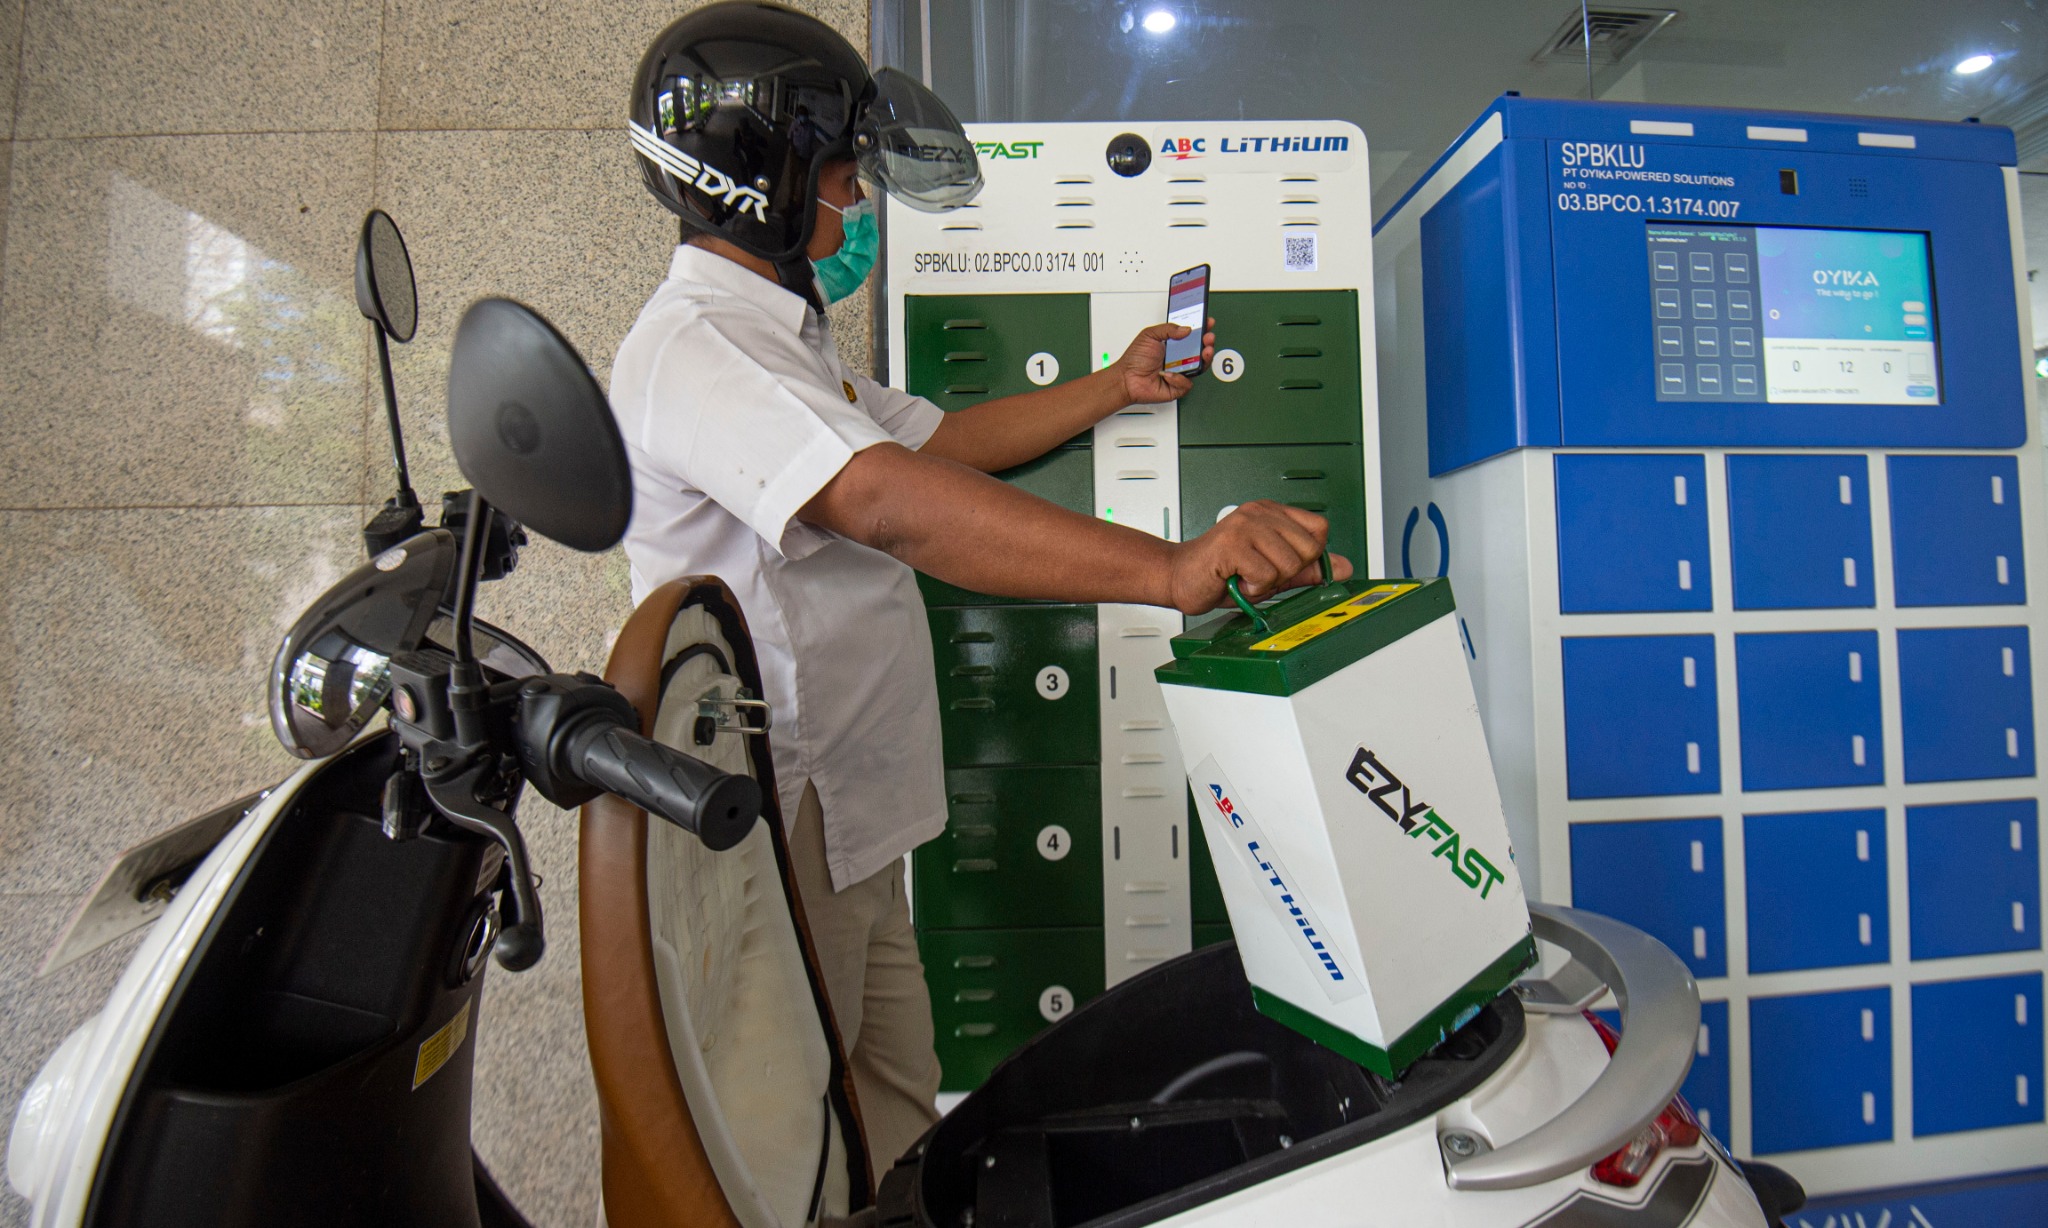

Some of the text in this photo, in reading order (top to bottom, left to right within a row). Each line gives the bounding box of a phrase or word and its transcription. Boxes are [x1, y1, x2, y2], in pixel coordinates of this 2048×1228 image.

[1160, 138, 1206, 153] ABC
[1561, 142, 1645, 168] SPBKLU
[1562, 168, 1735, 187] PT OYIKA POWERED SOLUTIONS
[1563, 181, 1577, 189] NO
[1557, 193, 1740, 218] 03.BPCO.1.3174.007
[914, 252, 1105, 273] SPBKLU: 02.BPCO.0 3174 001
[1812, 269, 1879, 287] OYIKA
[1816, 288, 1832, 297] The
[1832, 289, 1852, 301] way
[1036, 359, 1046, 377] 1
[1221, 357, 1234, 375] 6
[1792, 360, 1801, 373] 0
[1839, 361, 1854, 373] 12
[1883, 361, 1891, 374] 0
[1046, 674, 1059, 692] 3
[1209, 783, 1244, 829] ABC
[1345, 745, 1505, 900] EZYFAST
[1046, 834, 1060, 851] 4
[1050, 995, 1063, 1012] 5
